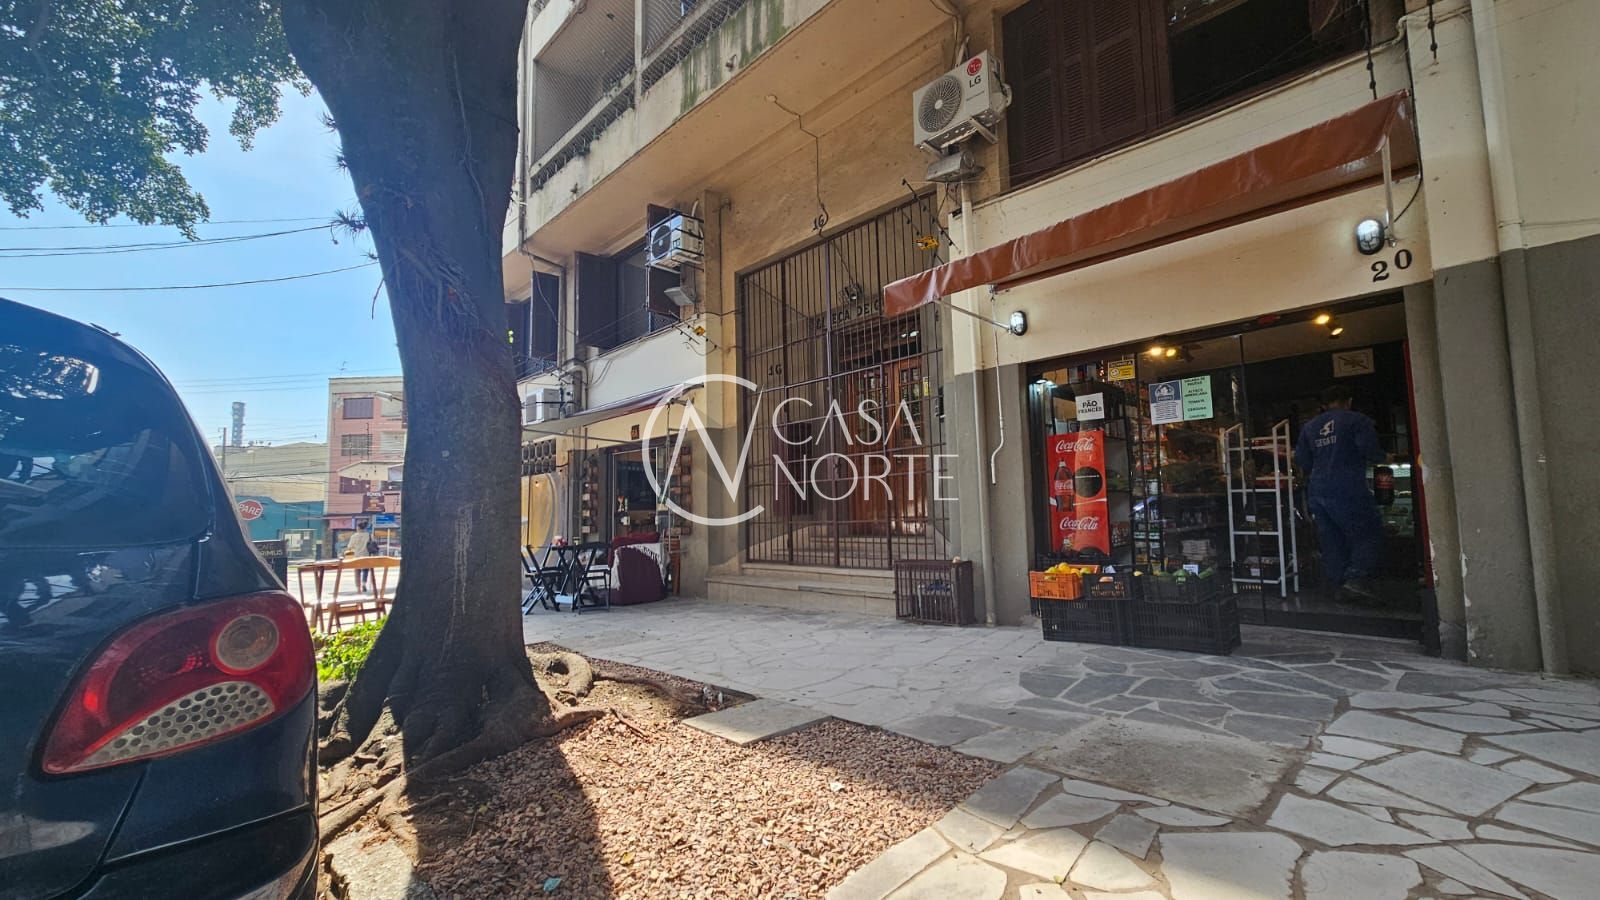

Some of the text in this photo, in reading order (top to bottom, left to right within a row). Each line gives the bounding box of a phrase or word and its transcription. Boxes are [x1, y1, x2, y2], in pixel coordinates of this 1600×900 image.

[969, 75, 981, 88] LG
[1371, 249, 1413, 283] 20
[768, 364, 782, 375] 16
[1082, 400, 1098, 408] PÃO
[1056, 436, 1095, 454] Coca-Cola
[239, 503, 261, 516] PARE
[1060, 516, 1099, 530] Coca-Cola
